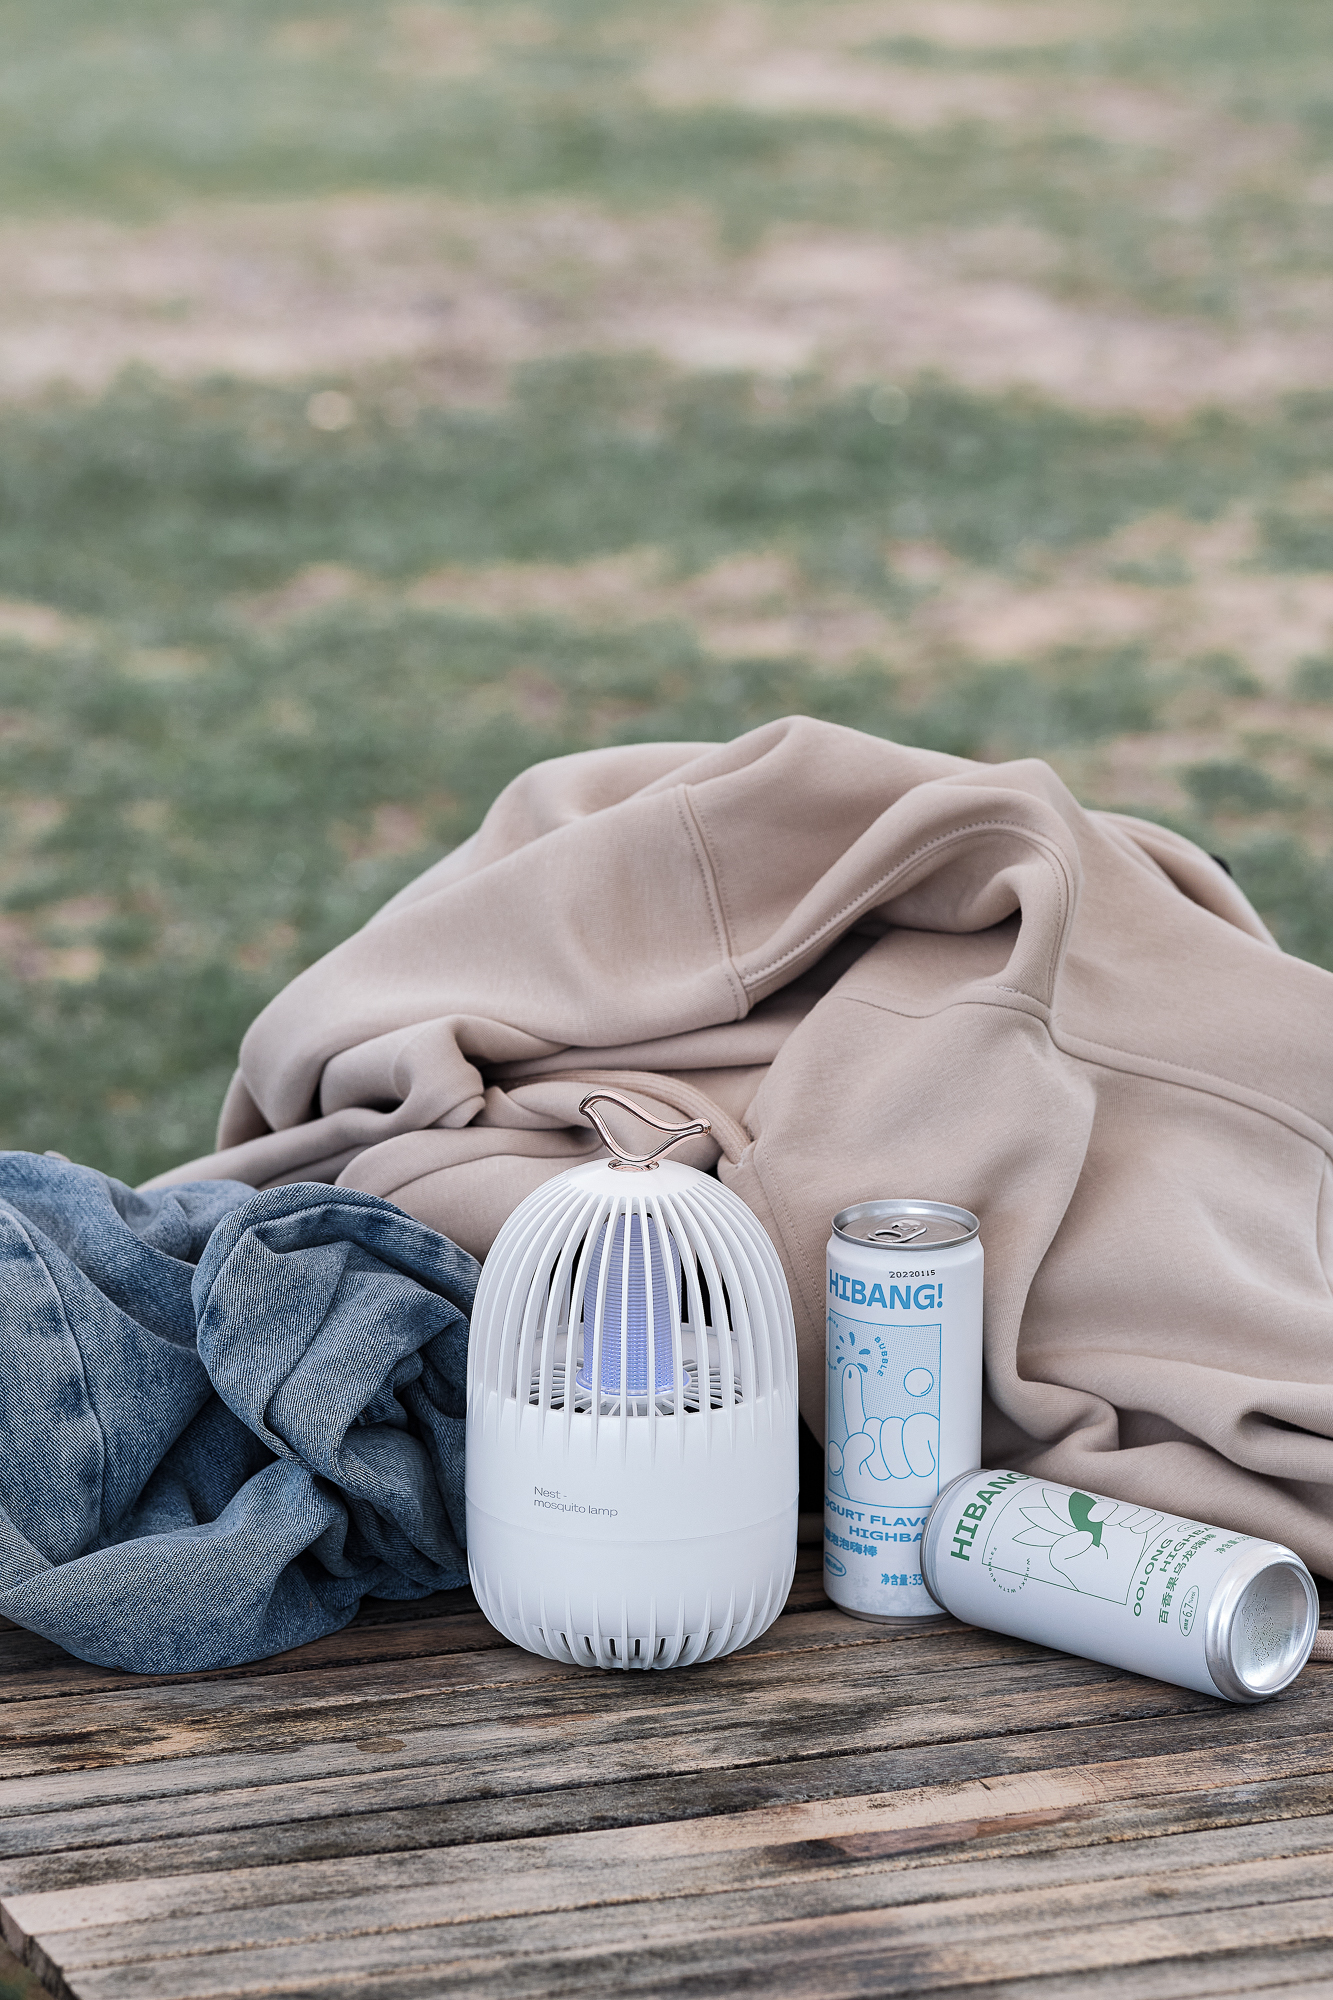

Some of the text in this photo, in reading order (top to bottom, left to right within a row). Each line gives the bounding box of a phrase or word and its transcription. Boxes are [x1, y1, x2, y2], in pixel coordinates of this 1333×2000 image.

[829, 1268, 943, 1310] HIBANG!
[889, 1269, 936, 1279] 20220115
[534, 1486, 561, 1499] Nest
[533, 1499, 619, 1518] mosquito lamp
[1133, 1538, 1174, 1617] OOLONG
[1158, 1533, 1217, 1624] 百香果乌龙嗨棒
